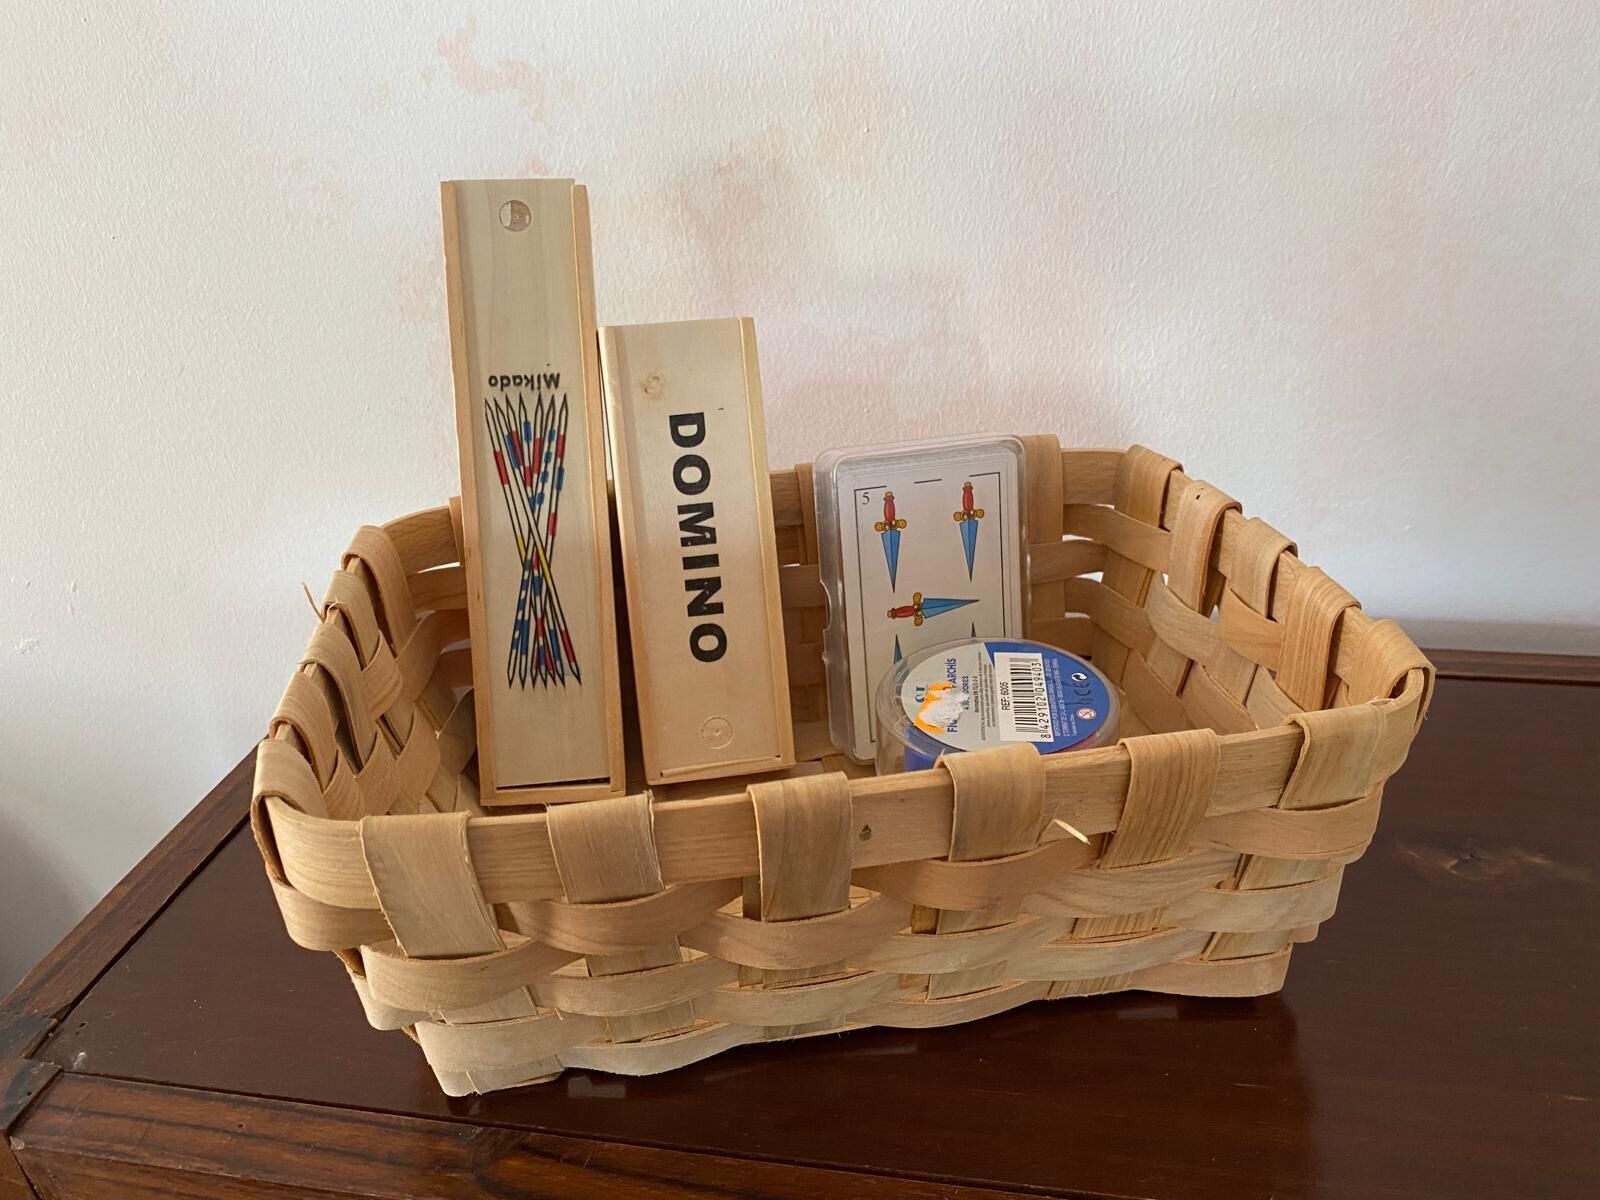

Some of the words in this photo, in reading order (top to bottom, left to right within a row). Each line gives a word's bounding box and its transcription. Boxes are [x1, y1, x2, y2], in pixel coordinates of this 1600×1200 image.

[488, 372, 561, 392] Mikado
[862, 491, 870, 505] 5
[668, 411, 728, 663] DOMINO
[1031, 662, 1045, 693] 049403
[1000, 696, 1011, 711] REF:
[1035, 696, 1049, 730] 429102
